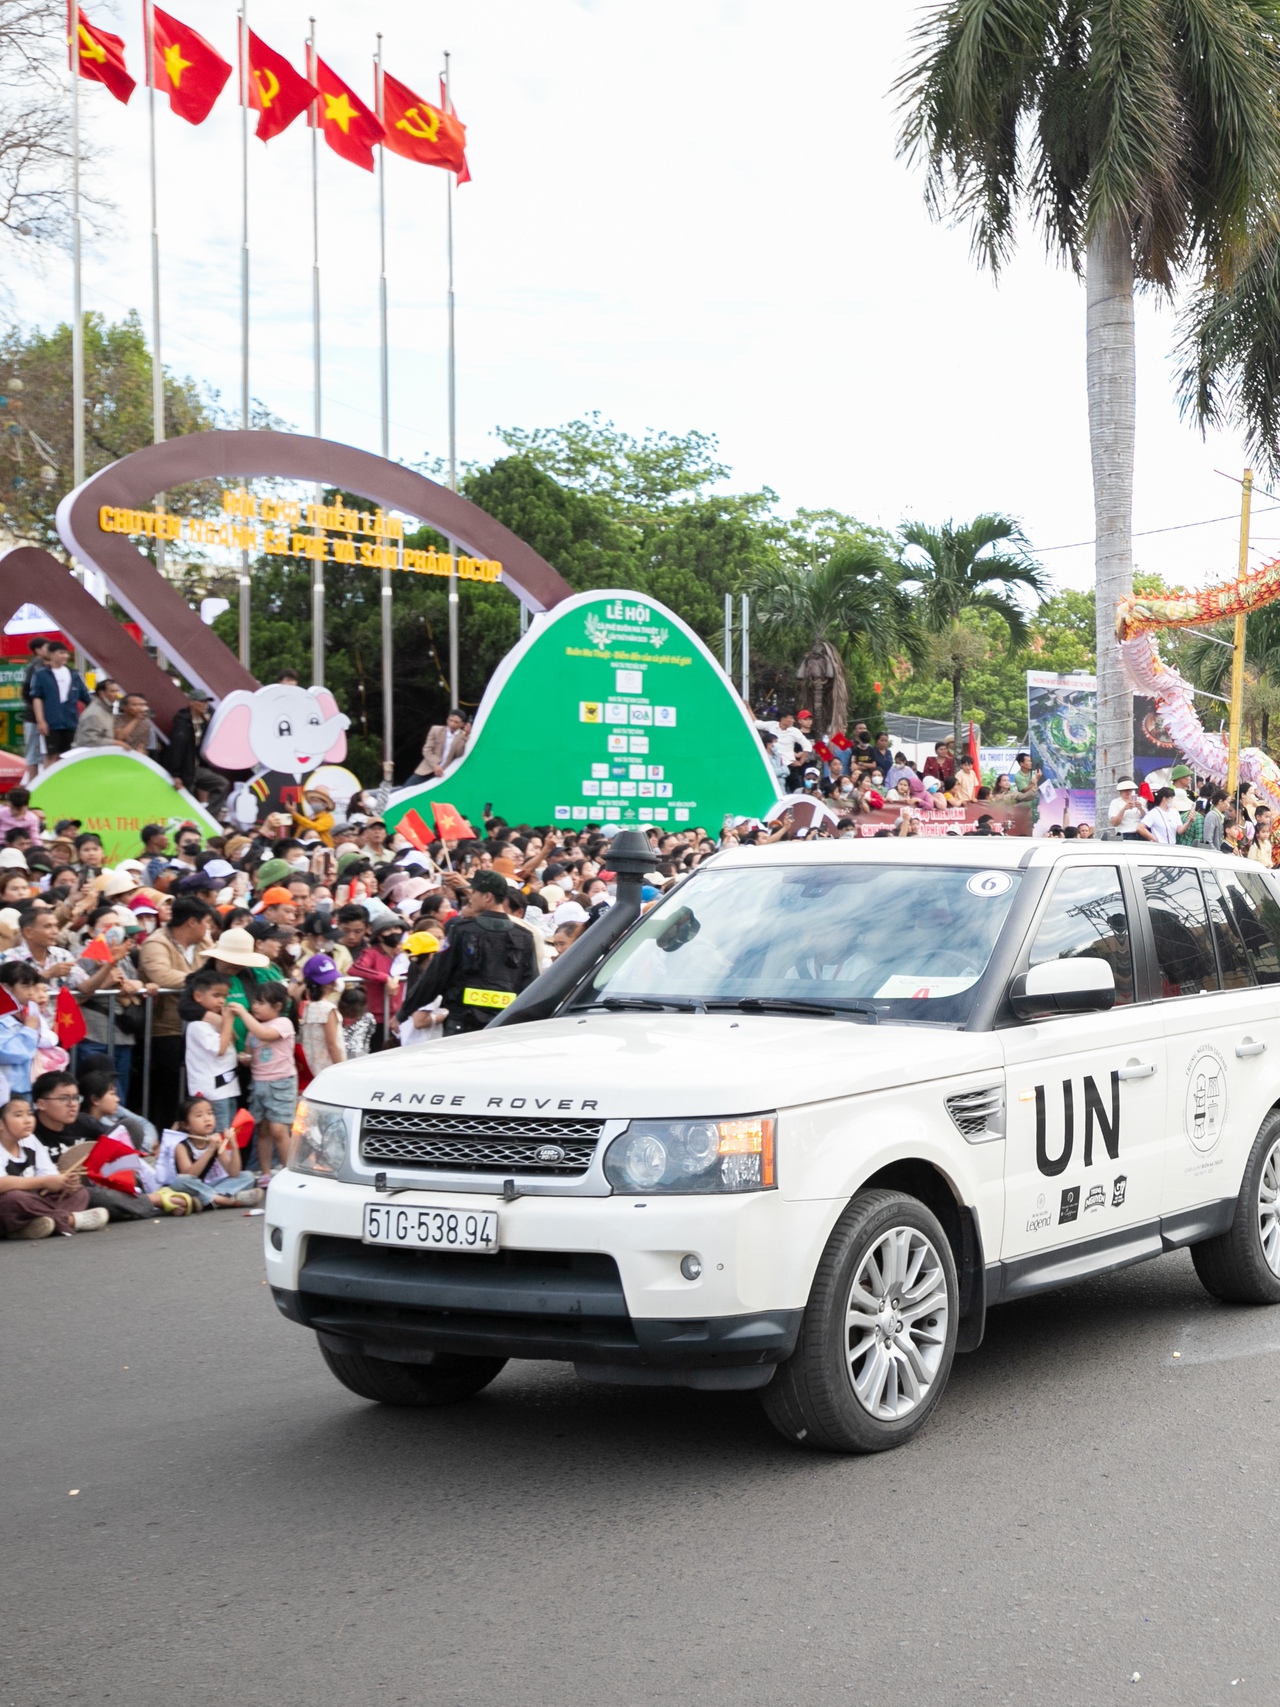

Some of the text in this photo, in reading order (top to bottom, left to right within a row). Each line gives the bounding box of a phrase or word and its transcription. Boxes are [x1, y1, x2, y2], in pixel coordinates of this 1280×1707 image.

[99, 505, 182, 541] CHUYÊN
[292, 530, 328, 562] PHÊ
[333, 533, 357, 565] VÀ
[457, 555, 503, 583] OCOP
[606, 600, 651, 625] LỄ HỘI
[981, 876, 999, 891] 6
[470, 991, 511, 1005] CSCĐ
[371, 1091, 599, 1111] RANGE ROVER
[1035, 1070, 1119, 1177] UN
[368, 1208, 492, 1247] 51G-538.94
[1026, 1213, 1051, 1232] Legend
